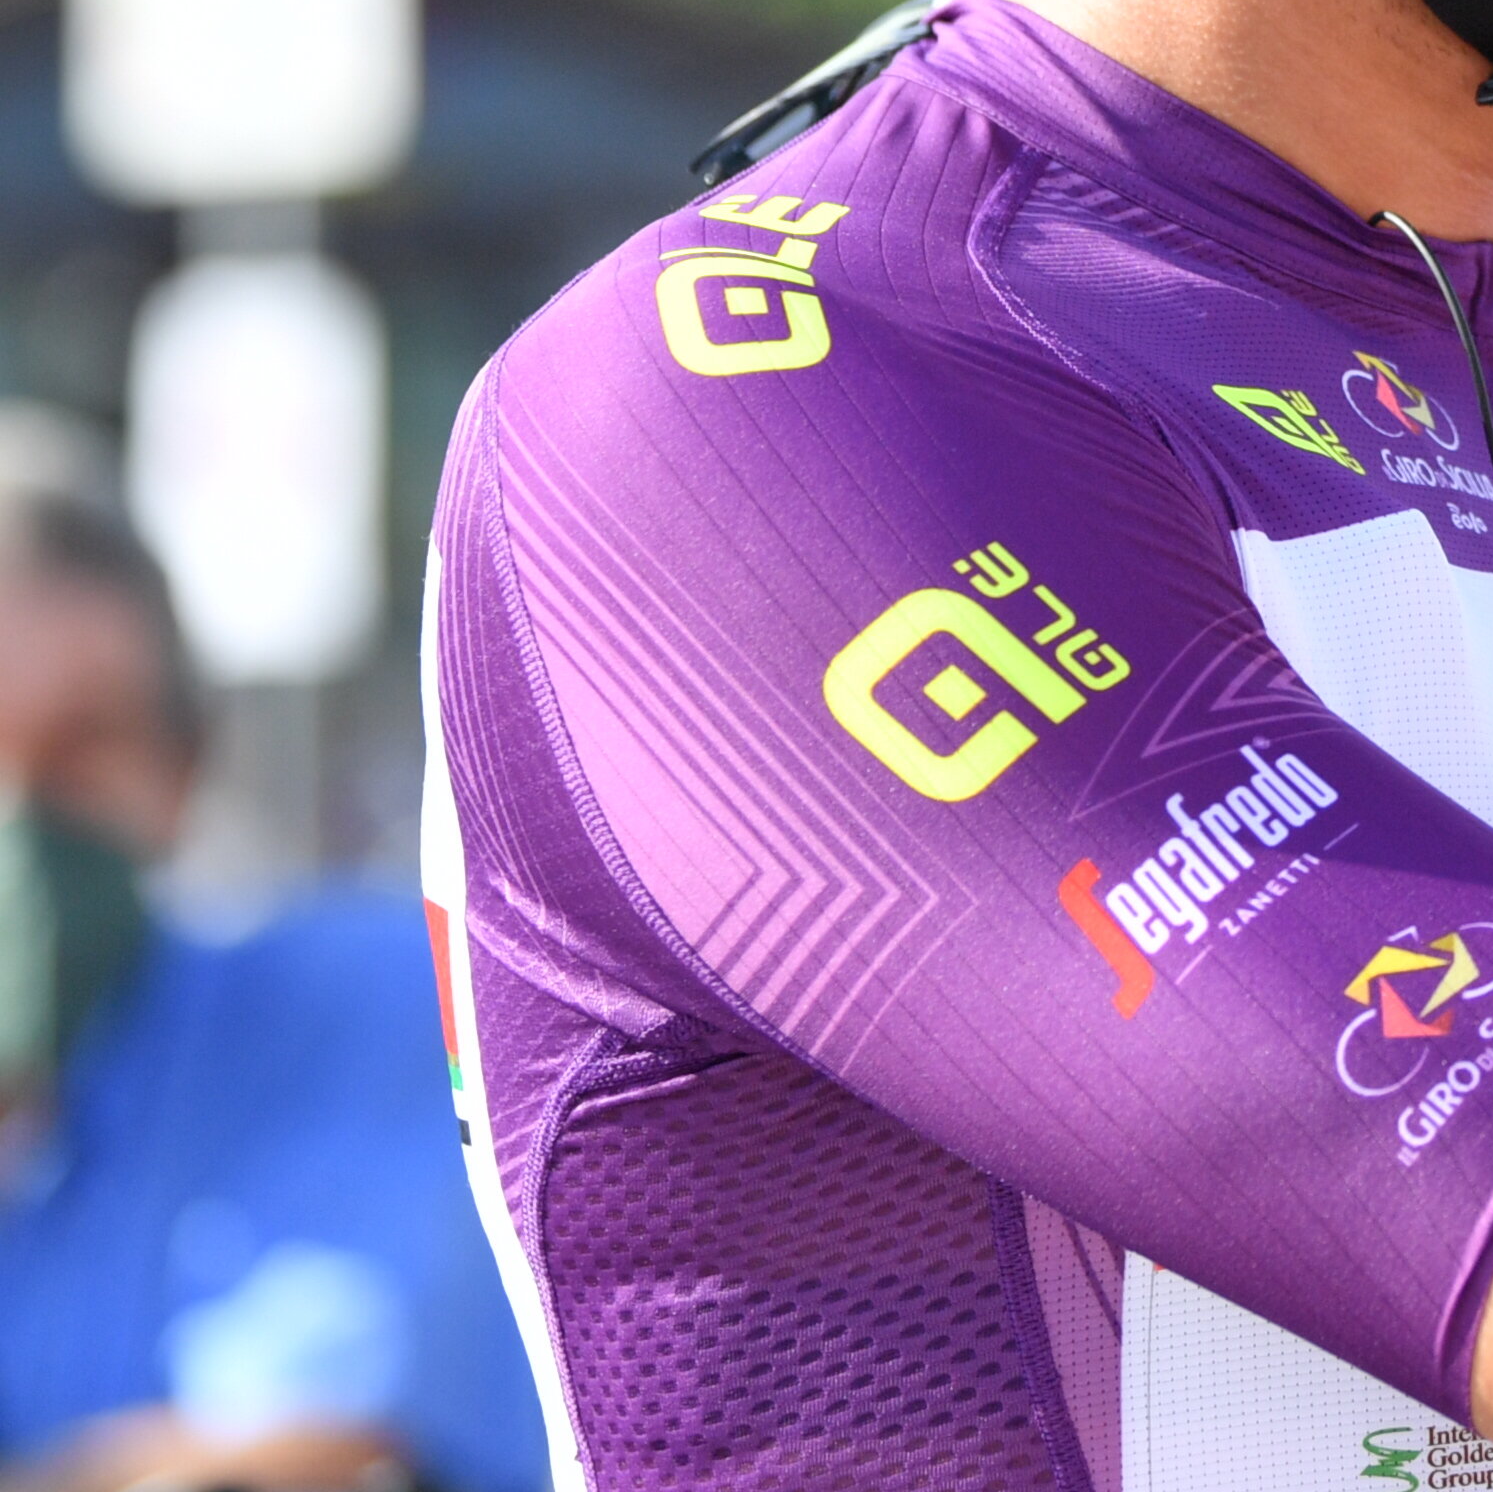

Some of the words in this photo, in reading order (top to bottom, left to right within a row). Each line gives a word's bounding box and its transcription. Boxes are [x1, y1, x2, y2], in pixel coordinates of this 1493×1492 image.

[1058, 744, 1338, 1020] Segafredo
[1218, 852, 1320, 936] ZANETTI
[1397, 1060, 1481, 1147] GIRO
